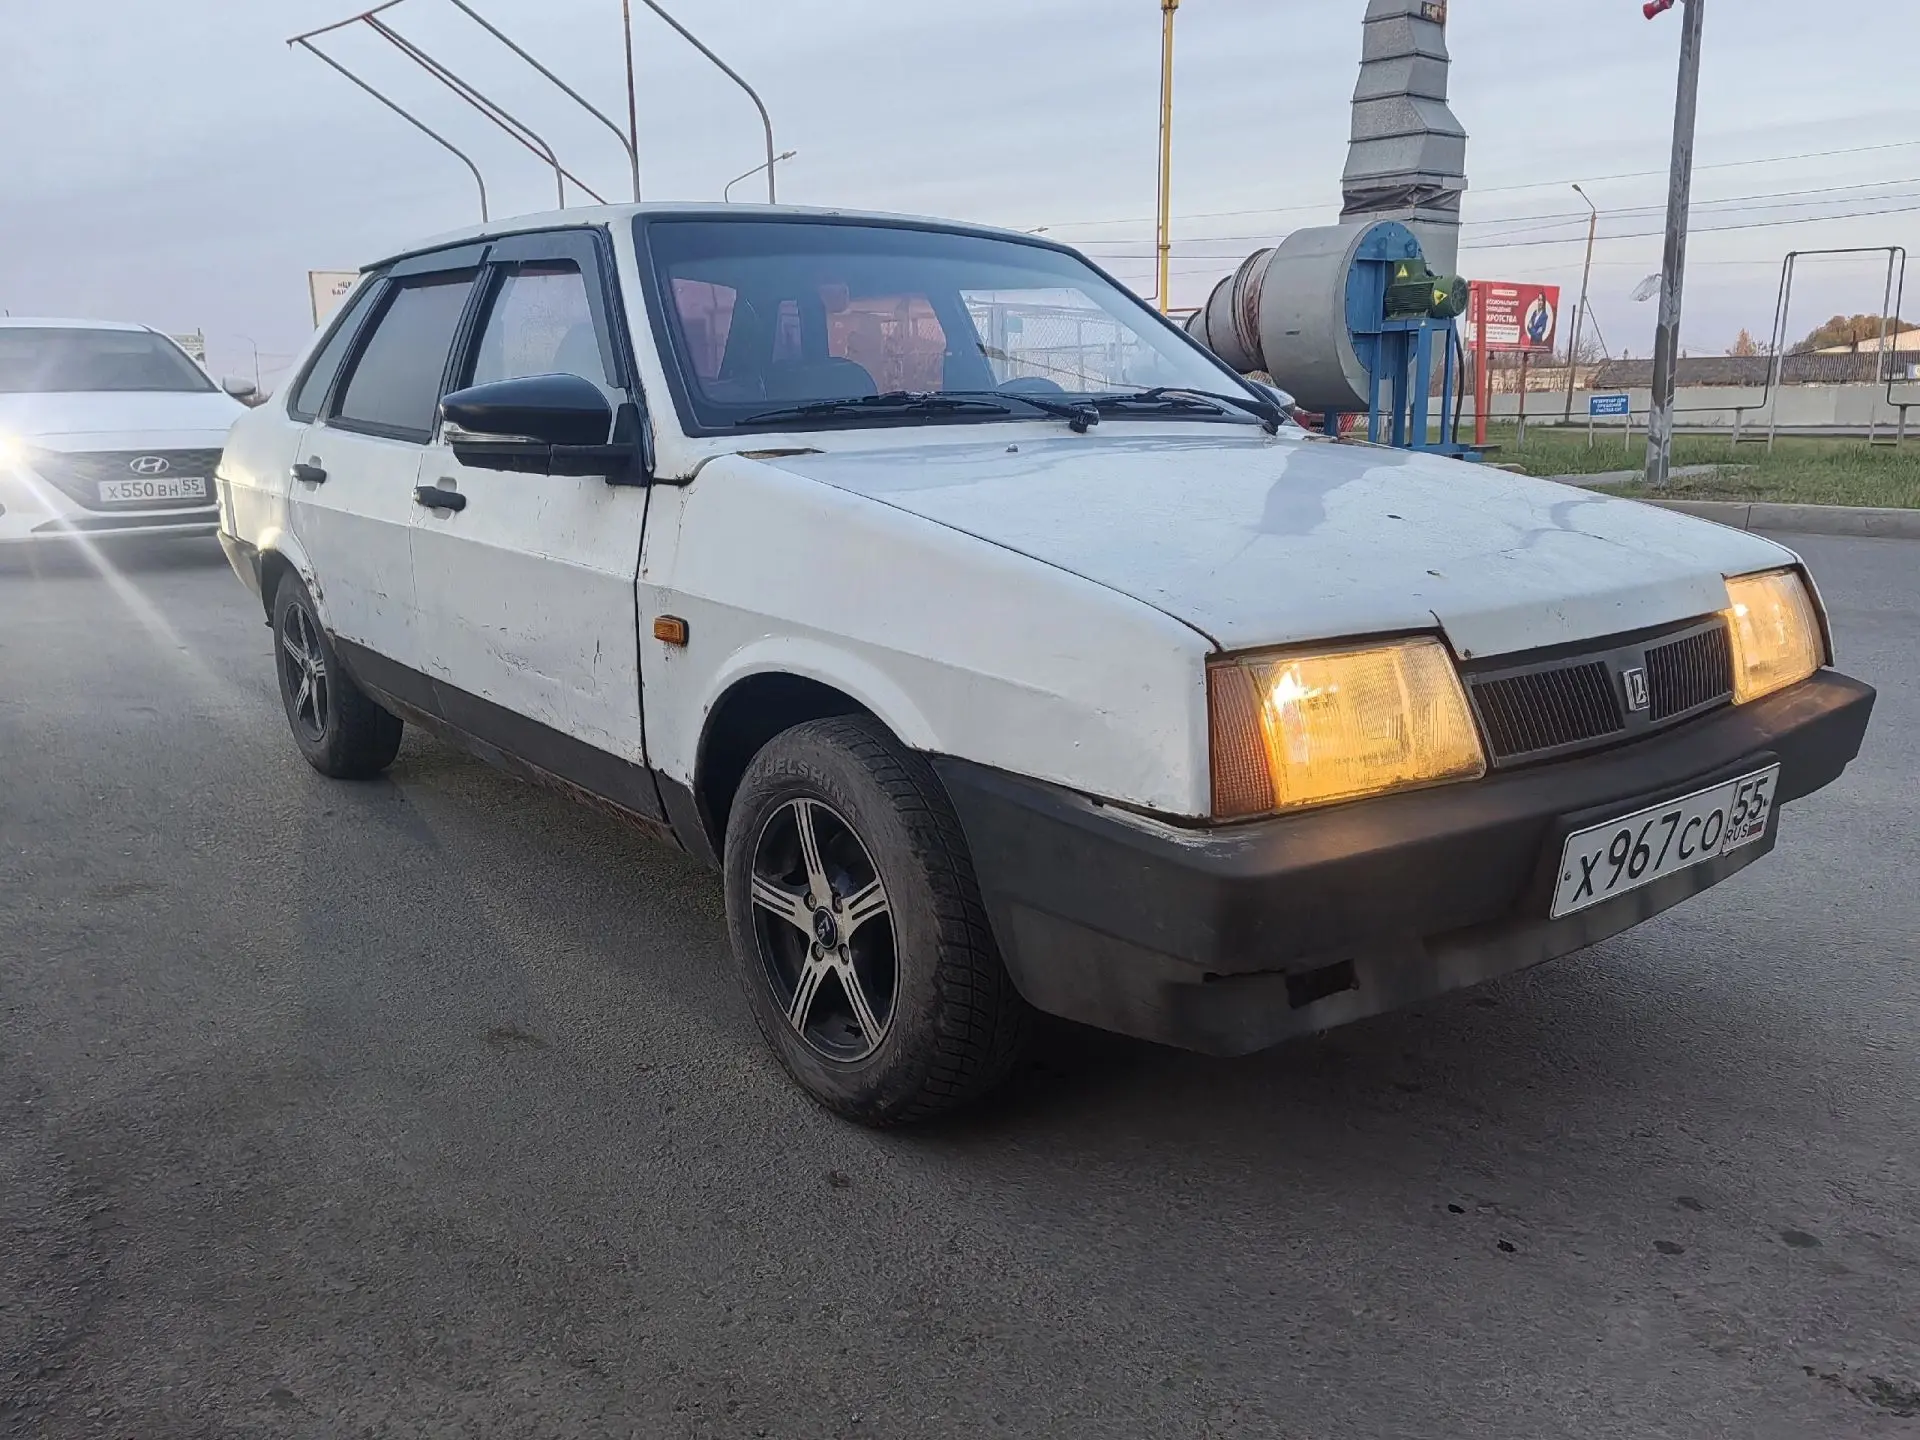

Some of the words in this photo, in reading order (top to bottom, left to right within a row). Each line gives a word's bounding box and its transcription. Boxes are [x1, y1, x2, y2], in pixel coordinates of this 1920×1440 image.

[182, 479, 200, 491] 55
[1571, 808, 1725, 903] Х967СО
[1732, 776, 1769, 827] 55
[1724, 826, 1749, 846] RUS
